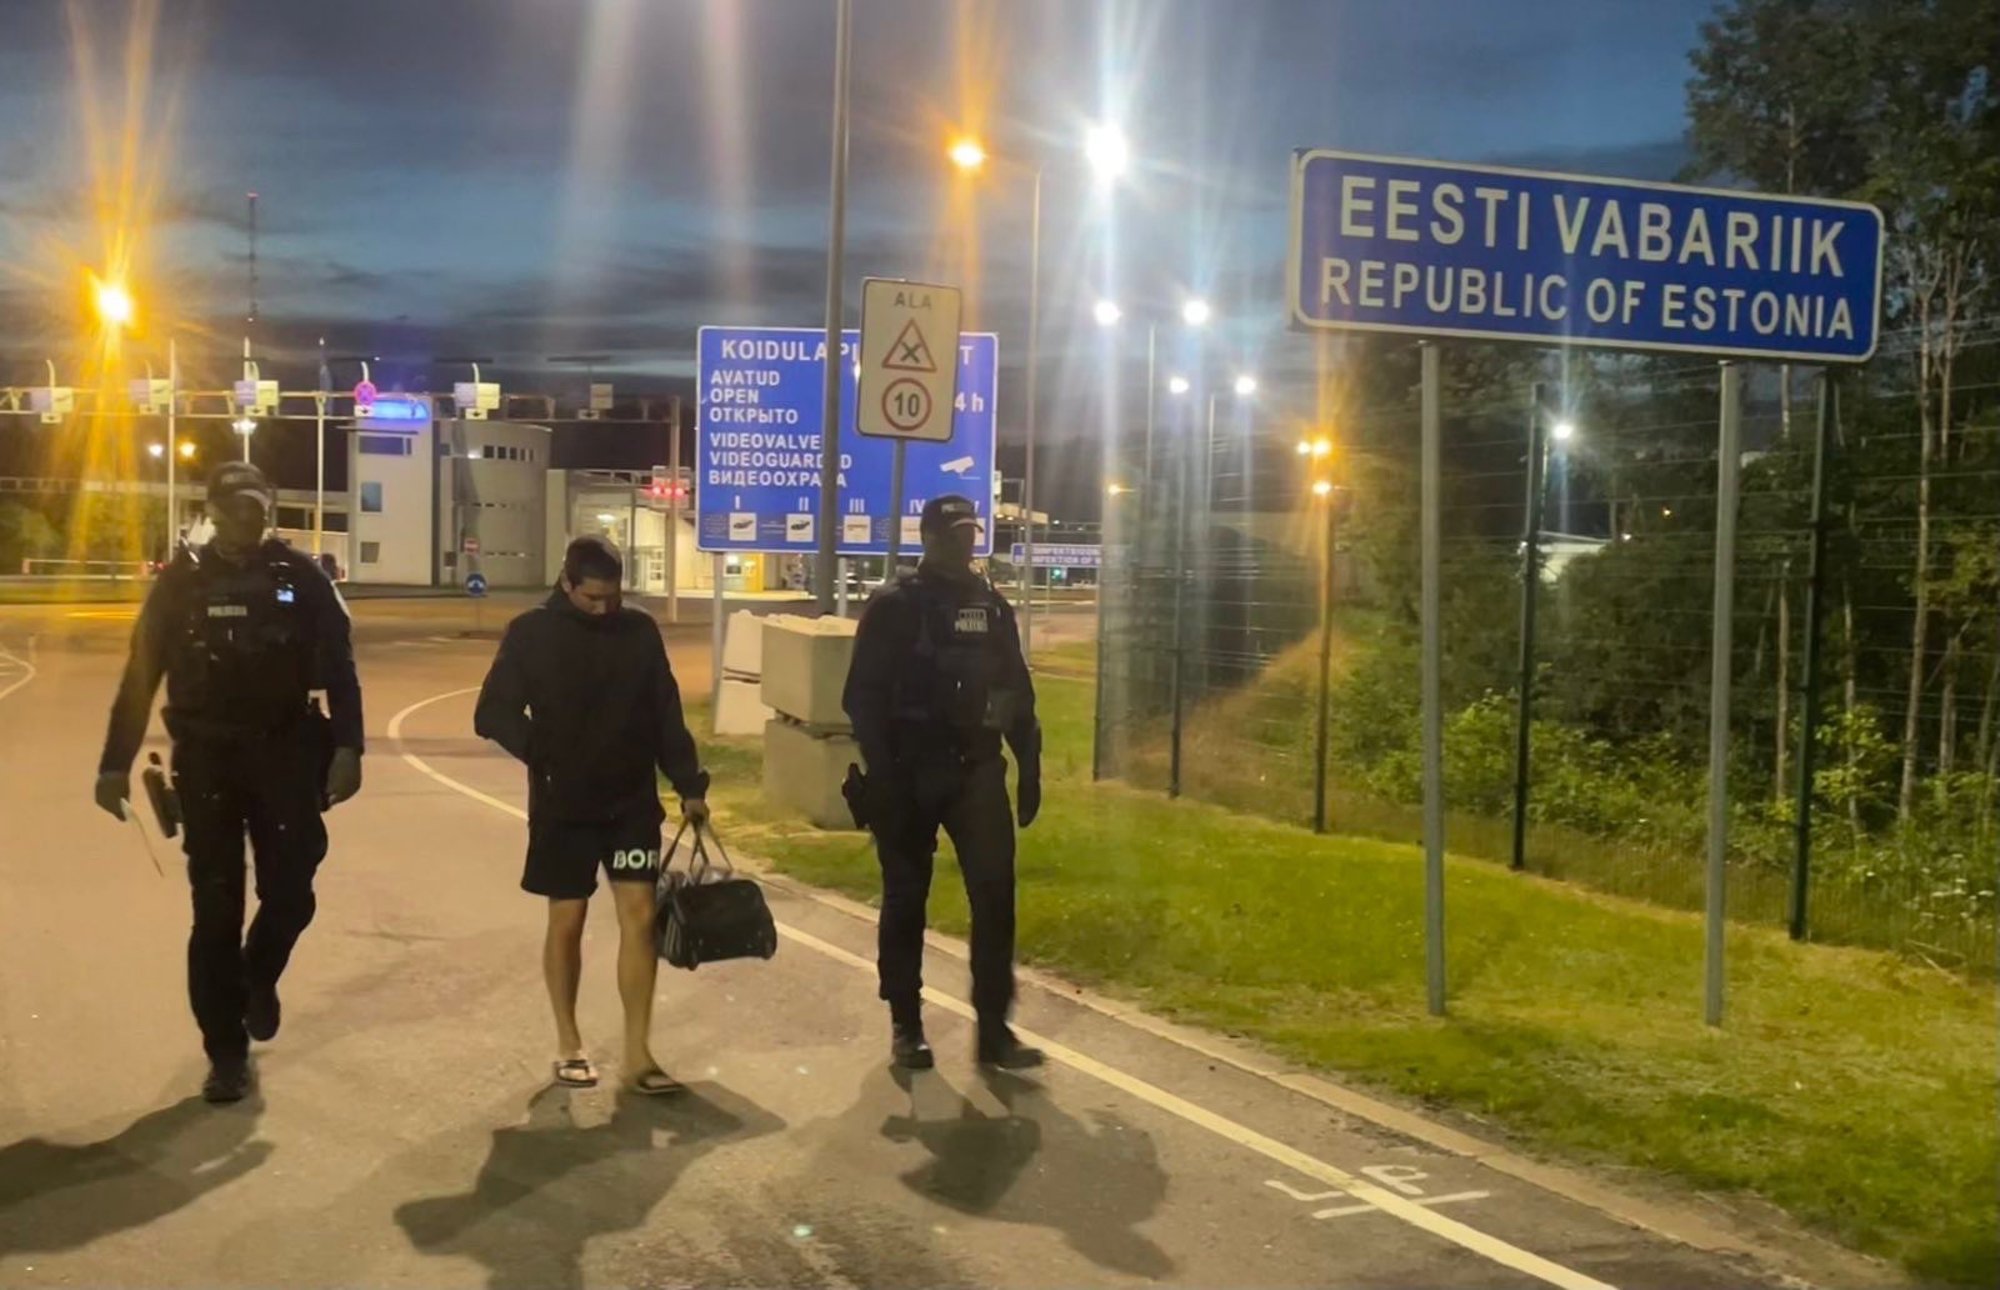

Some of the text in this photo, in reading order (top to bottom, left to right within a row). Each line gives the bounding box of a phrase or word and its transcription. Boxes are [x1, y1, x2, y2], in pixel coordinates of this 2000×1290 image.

[1340, 175, 1846, 278] EESTI VABARIIK
[894, 291, 932, 310] ALA
[1321, 257, 1854, 340] REPUBLIC OF ESTONIA
[710, 370, 780, 386] AVATUD
[710, 388, 759, 404] OPEN
[894, 391, 920, 418] 10
[971, 391, 984, 412] h
[709, 407, 798, 424] ОТКРЫТО
[709, 432, 821, 449] VIDEOVALVE
[709, 451, 852, 469] VIDEOGUARDD
[708, 470, 847, 487] ВИДЕООХРАА
[734, 495, 741, 510] I
[798, 497, 809, 511] II
[849, 498, 865, 513] III
